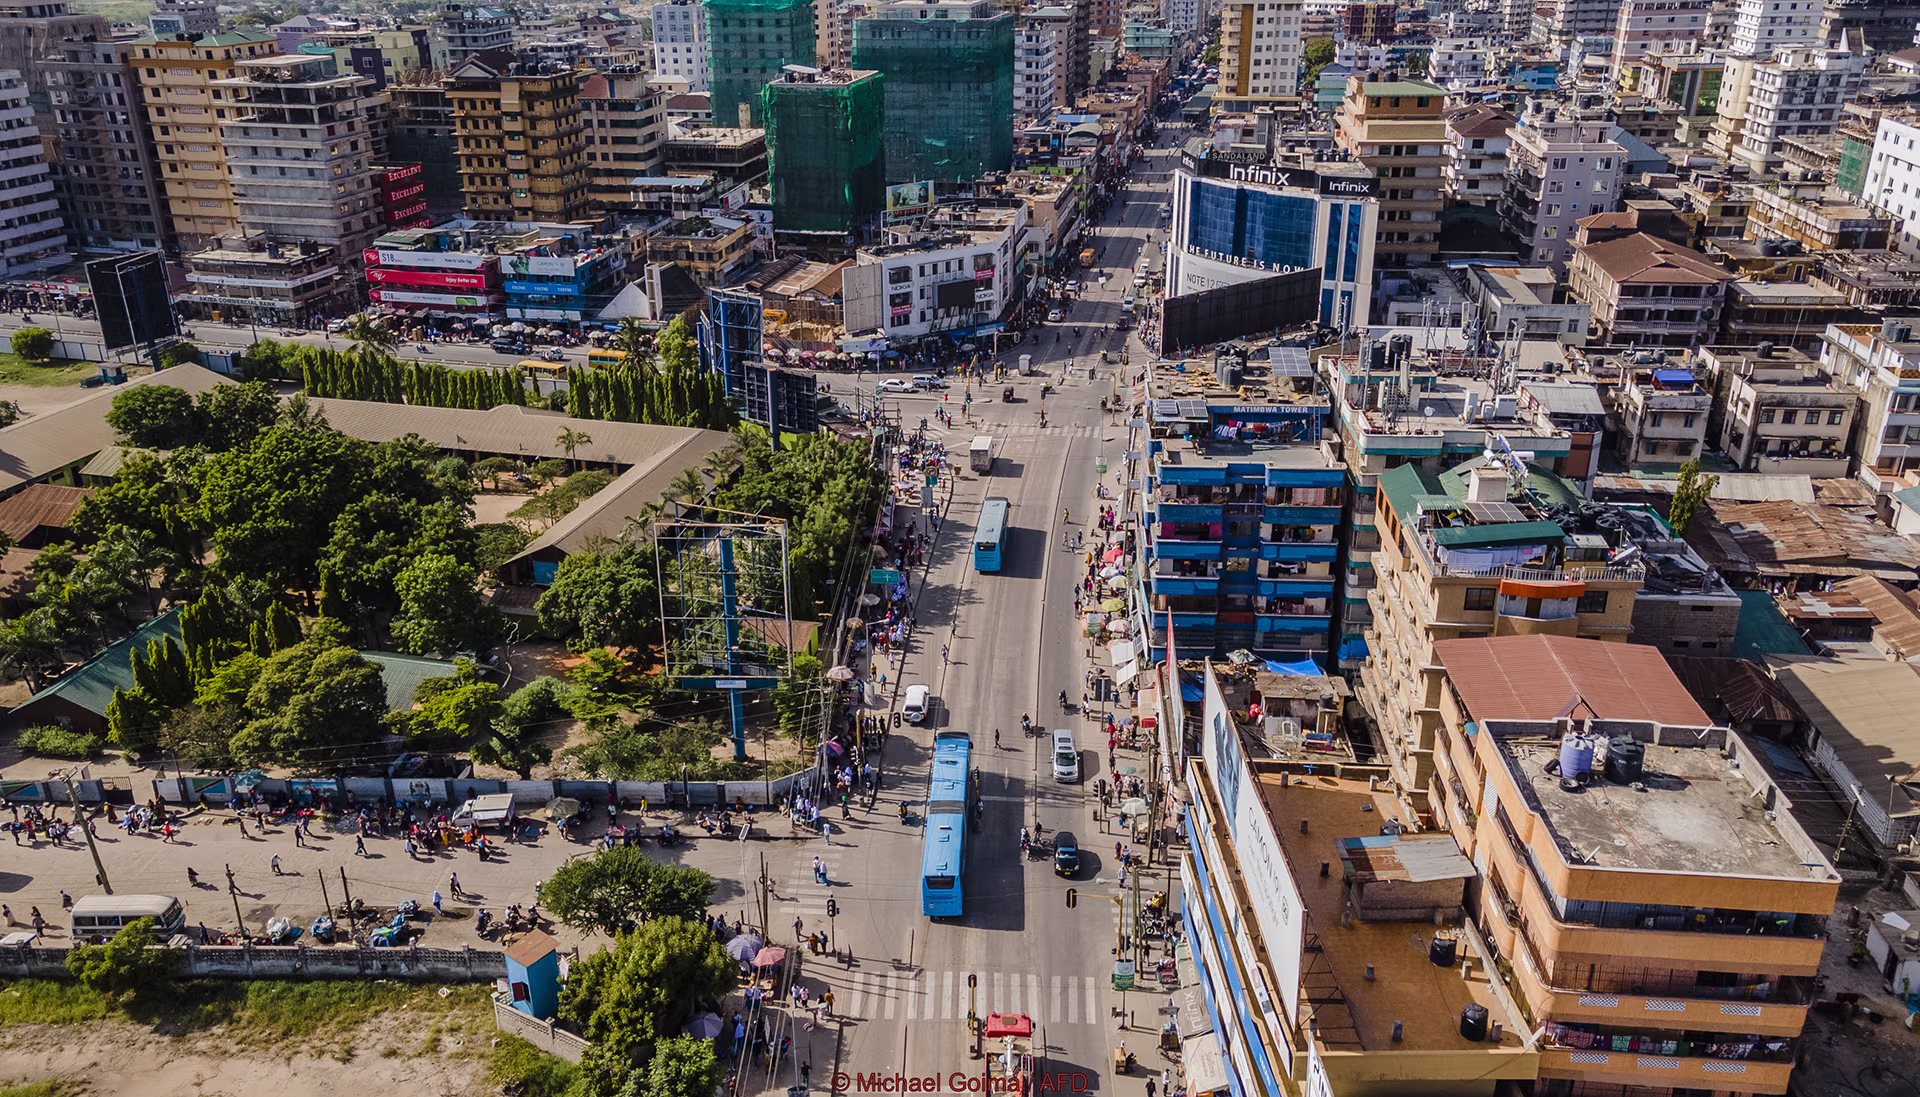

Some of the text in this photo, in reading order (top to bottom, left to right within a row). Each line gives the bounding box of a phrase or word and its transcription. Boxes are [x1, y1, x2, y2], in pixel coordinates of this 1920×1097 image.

[1212, 152, 1265, 160] SANDALAND
[388, 165, 421, 181] EXCELLENT
[1229, 163, 1290, 186] Infinix
[391, 184, 424, 200] EXCELLENT
[1329, 181, 1369, 193] Infinix
[394, 202, 427, 220] EXCELLENT
[382, 253, 395, 262] S18
[1204, 249, 1247, 267] FUTURE
[1253, 260, 1265, 270] IS
[1272, 262, 1305, 274] NOW
[1186, 272, 1205, 287] NOTE
[1207, 278, 1215, 289] 12
[891, 283, 911, 291] NOKIA
[383, 292, 394, 300] S18
[976, 291, 995, 300] NOKIA
[219, 298, 258, 307] COMMERCIAL
